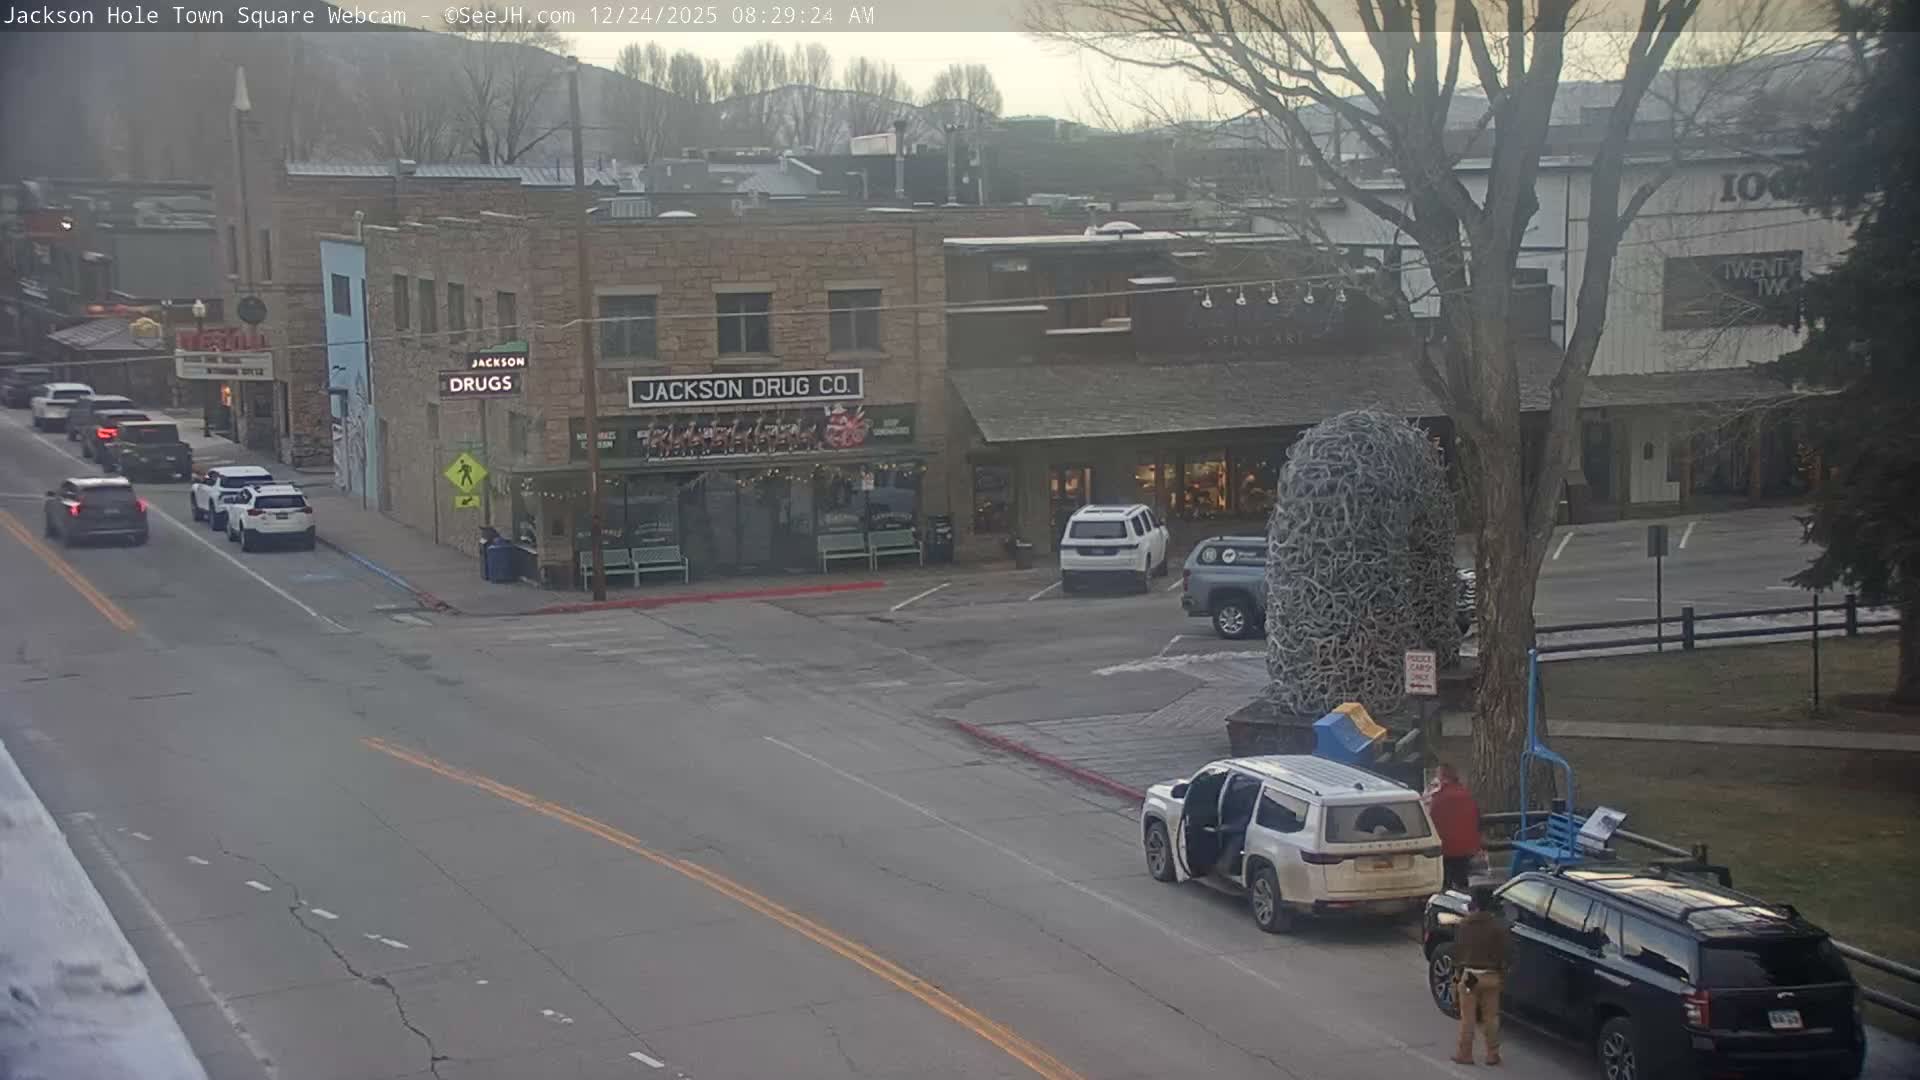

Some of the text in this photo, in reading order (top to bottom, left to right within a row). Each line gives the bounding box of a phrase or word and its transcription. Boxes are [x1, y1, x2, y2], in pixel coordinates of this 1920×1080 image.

[1722, 256, 1799, 281] TWENTY
[471, 357, 525, 368] JACKSON
[449, 375, 512, 393] DRUGS
[639, 375, 851, 401] JACKSON DRUG CO.
